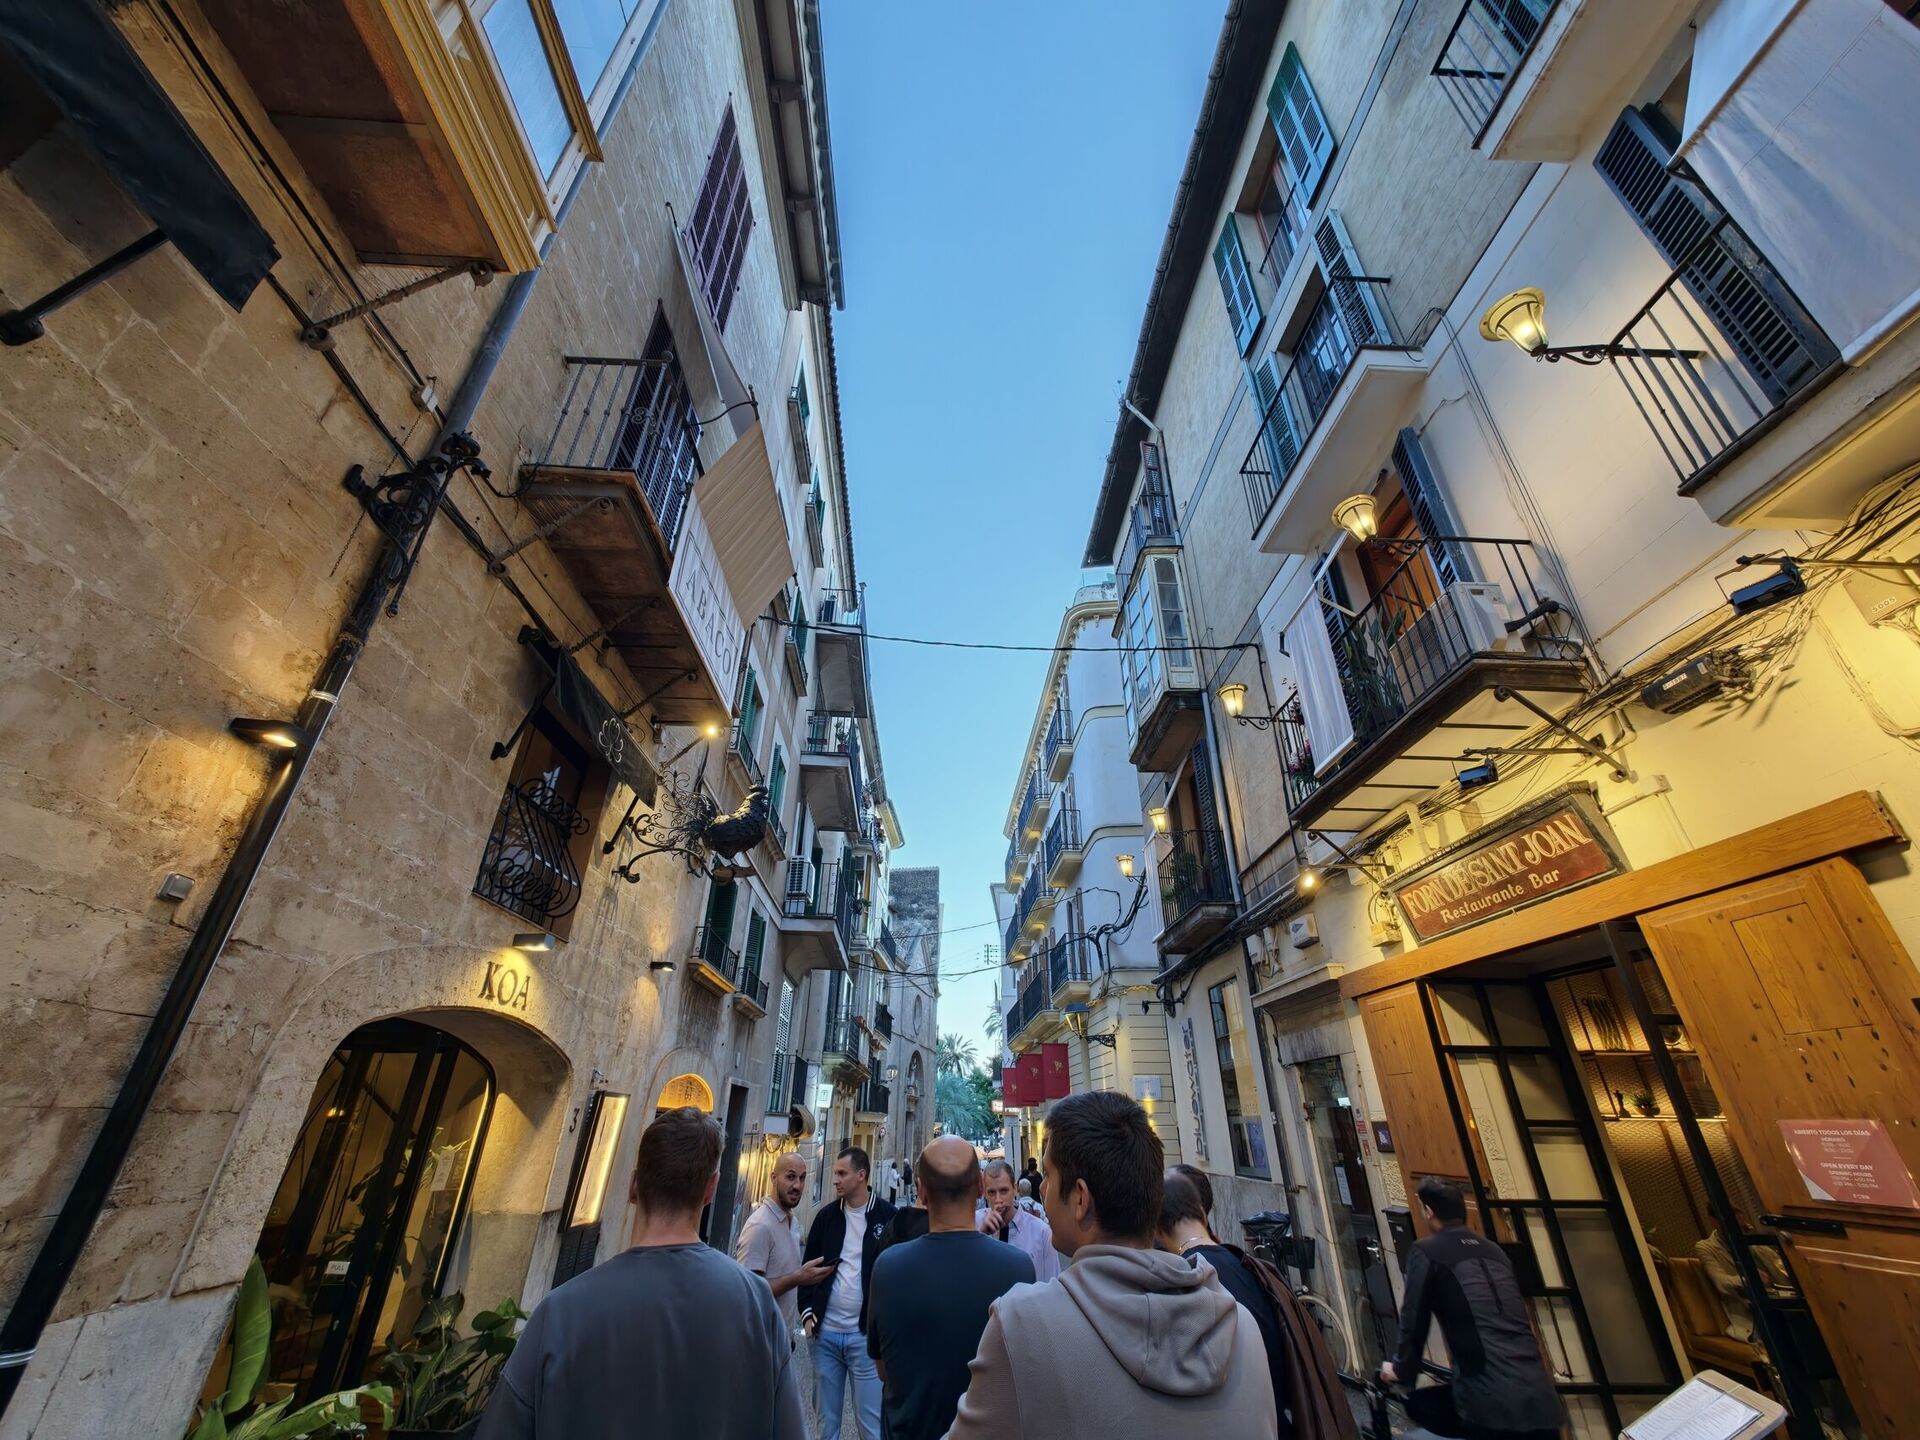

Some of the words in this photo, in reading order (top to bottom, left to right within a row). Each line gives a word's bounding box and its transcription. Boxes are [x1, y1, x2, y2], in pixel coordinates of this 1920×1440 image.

[686, 569, 732, 675] ABACO
[1401, 879, 1453, 919] FORN
[1440, 863, 1478, 899] DE
[1468, 841, 1528, 887] SANT
[1520, 814, 1593, 865] JOAN
[1440, 884, 1525, 923] Restaurante
[1528, 869, 1559, 889] Bar
[477, 961, 531, 1011] KOA
[569, 1107, 580, 1133] 3
[1182, 1025, 1204, 1155] bluewater
